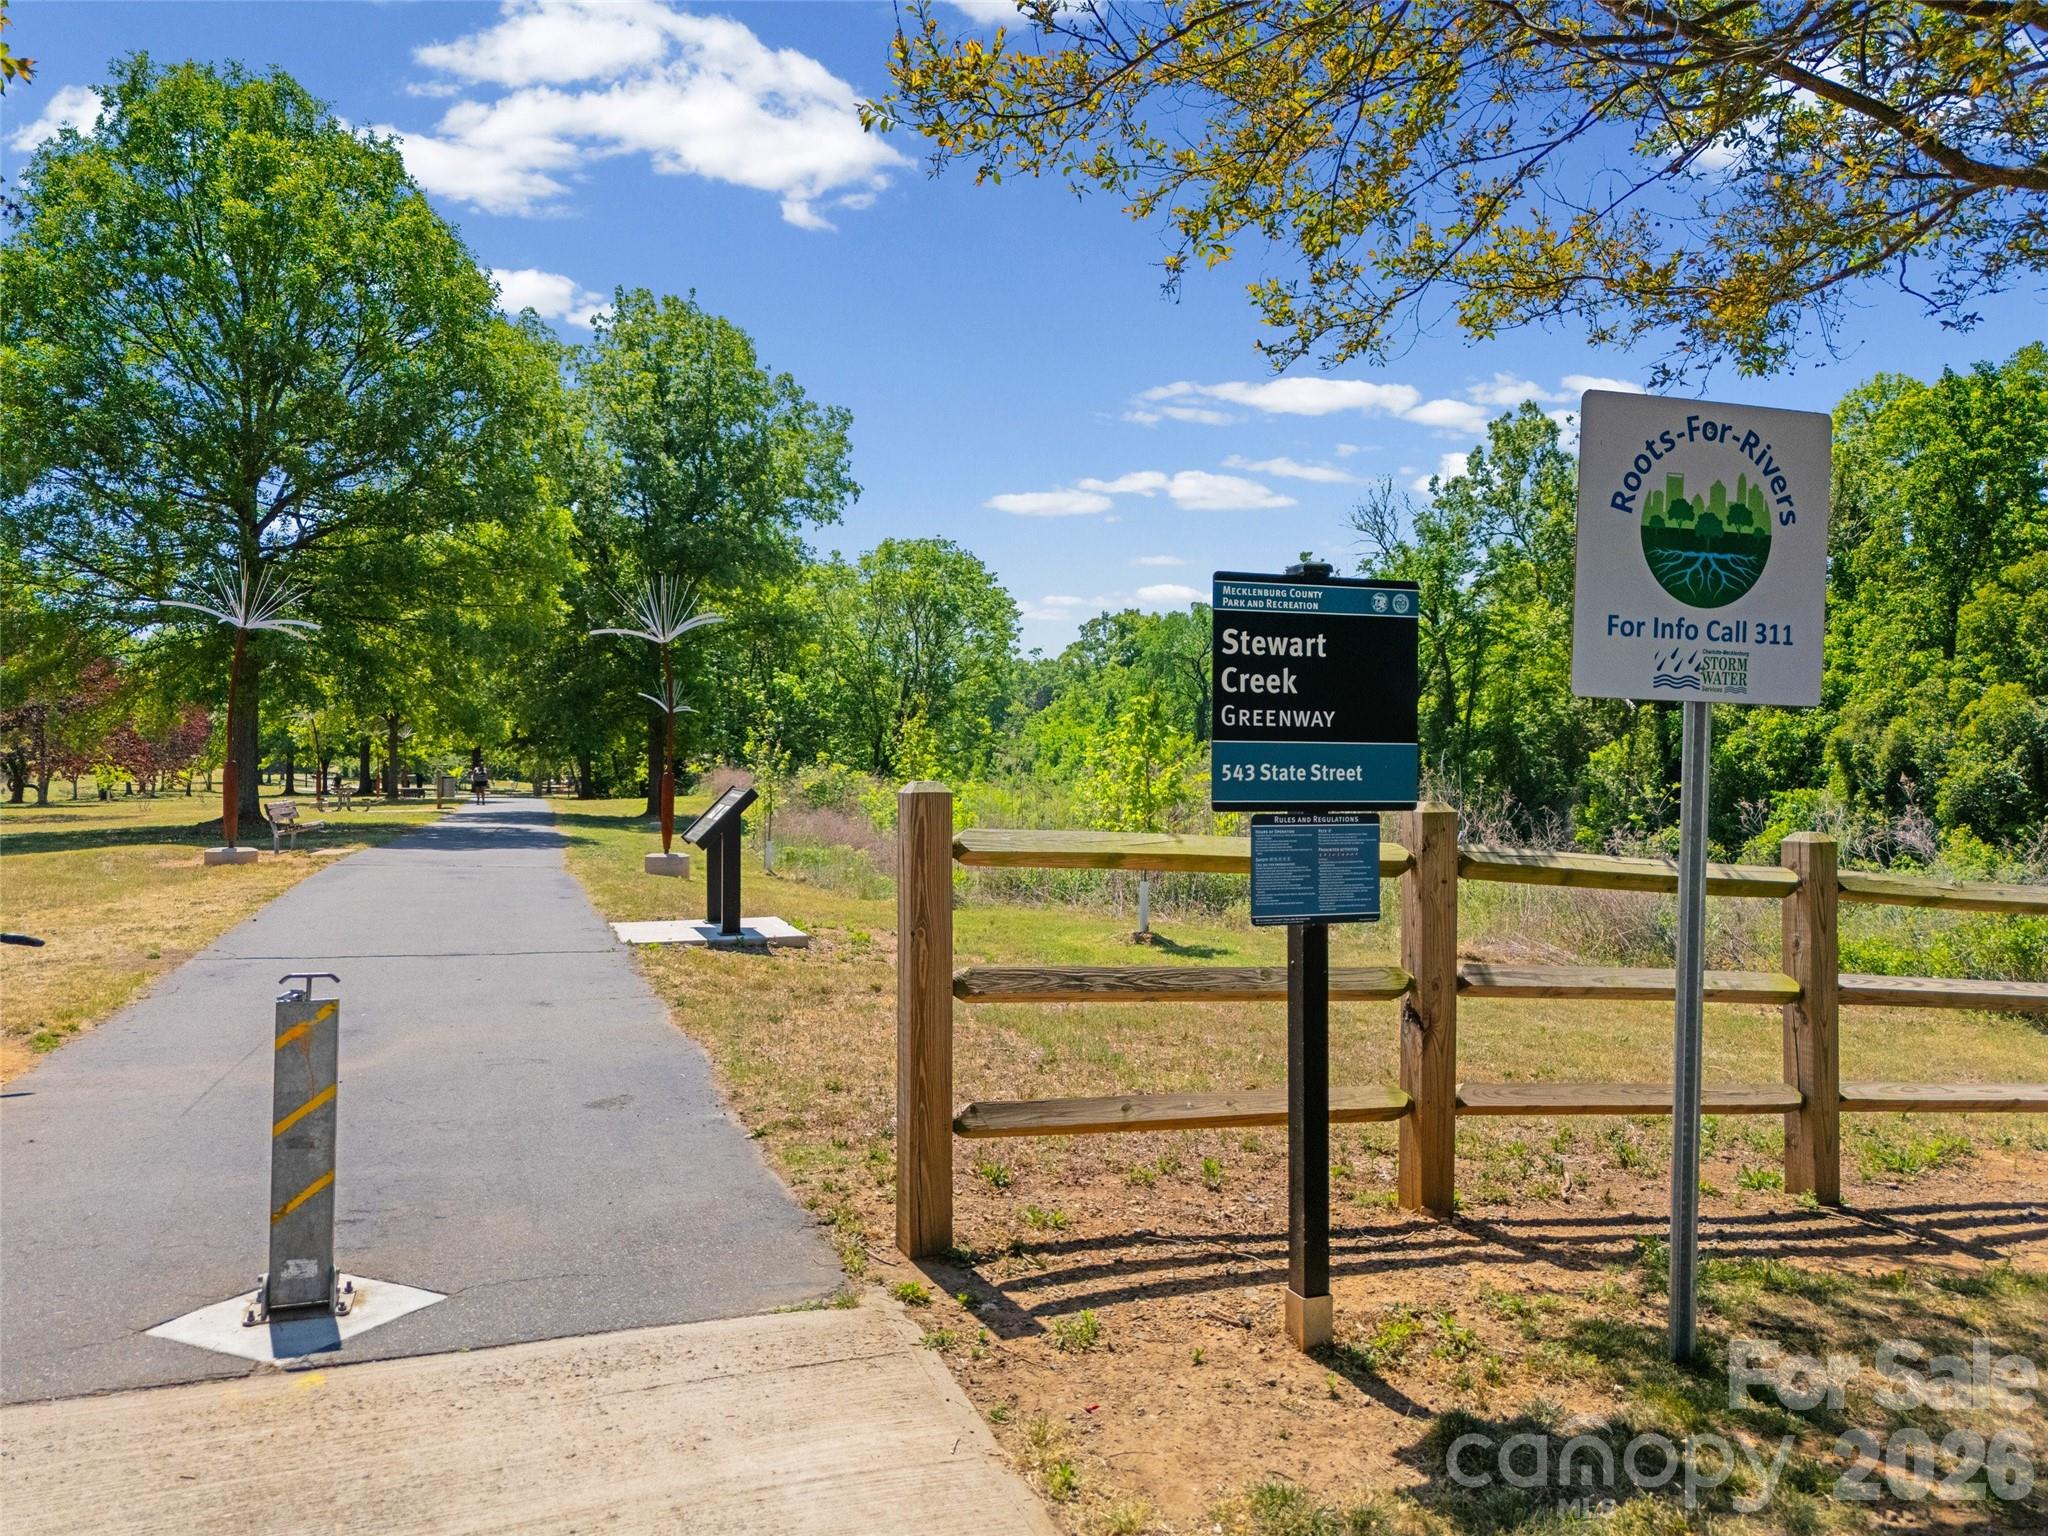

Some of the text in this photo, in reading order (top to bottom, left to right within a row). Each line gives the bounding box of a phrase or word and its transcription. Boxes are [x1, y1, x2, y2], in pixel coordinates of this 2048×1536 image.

[1222, 597, 1319, 610] PARK AND RECREATION
[1607, 614, 1794, 646] For Info Call 311
[1222, 628, 1327, 658] Stewart
[1702, 656, 1748, 671] STORM
[1221, 667, 1298, 694] Creek
[1701, 671, 1748, 686] WATER
[1221, 704, 1336, 728] GREENWAY
[1221, 763, 1363, 782] 543 State Street
